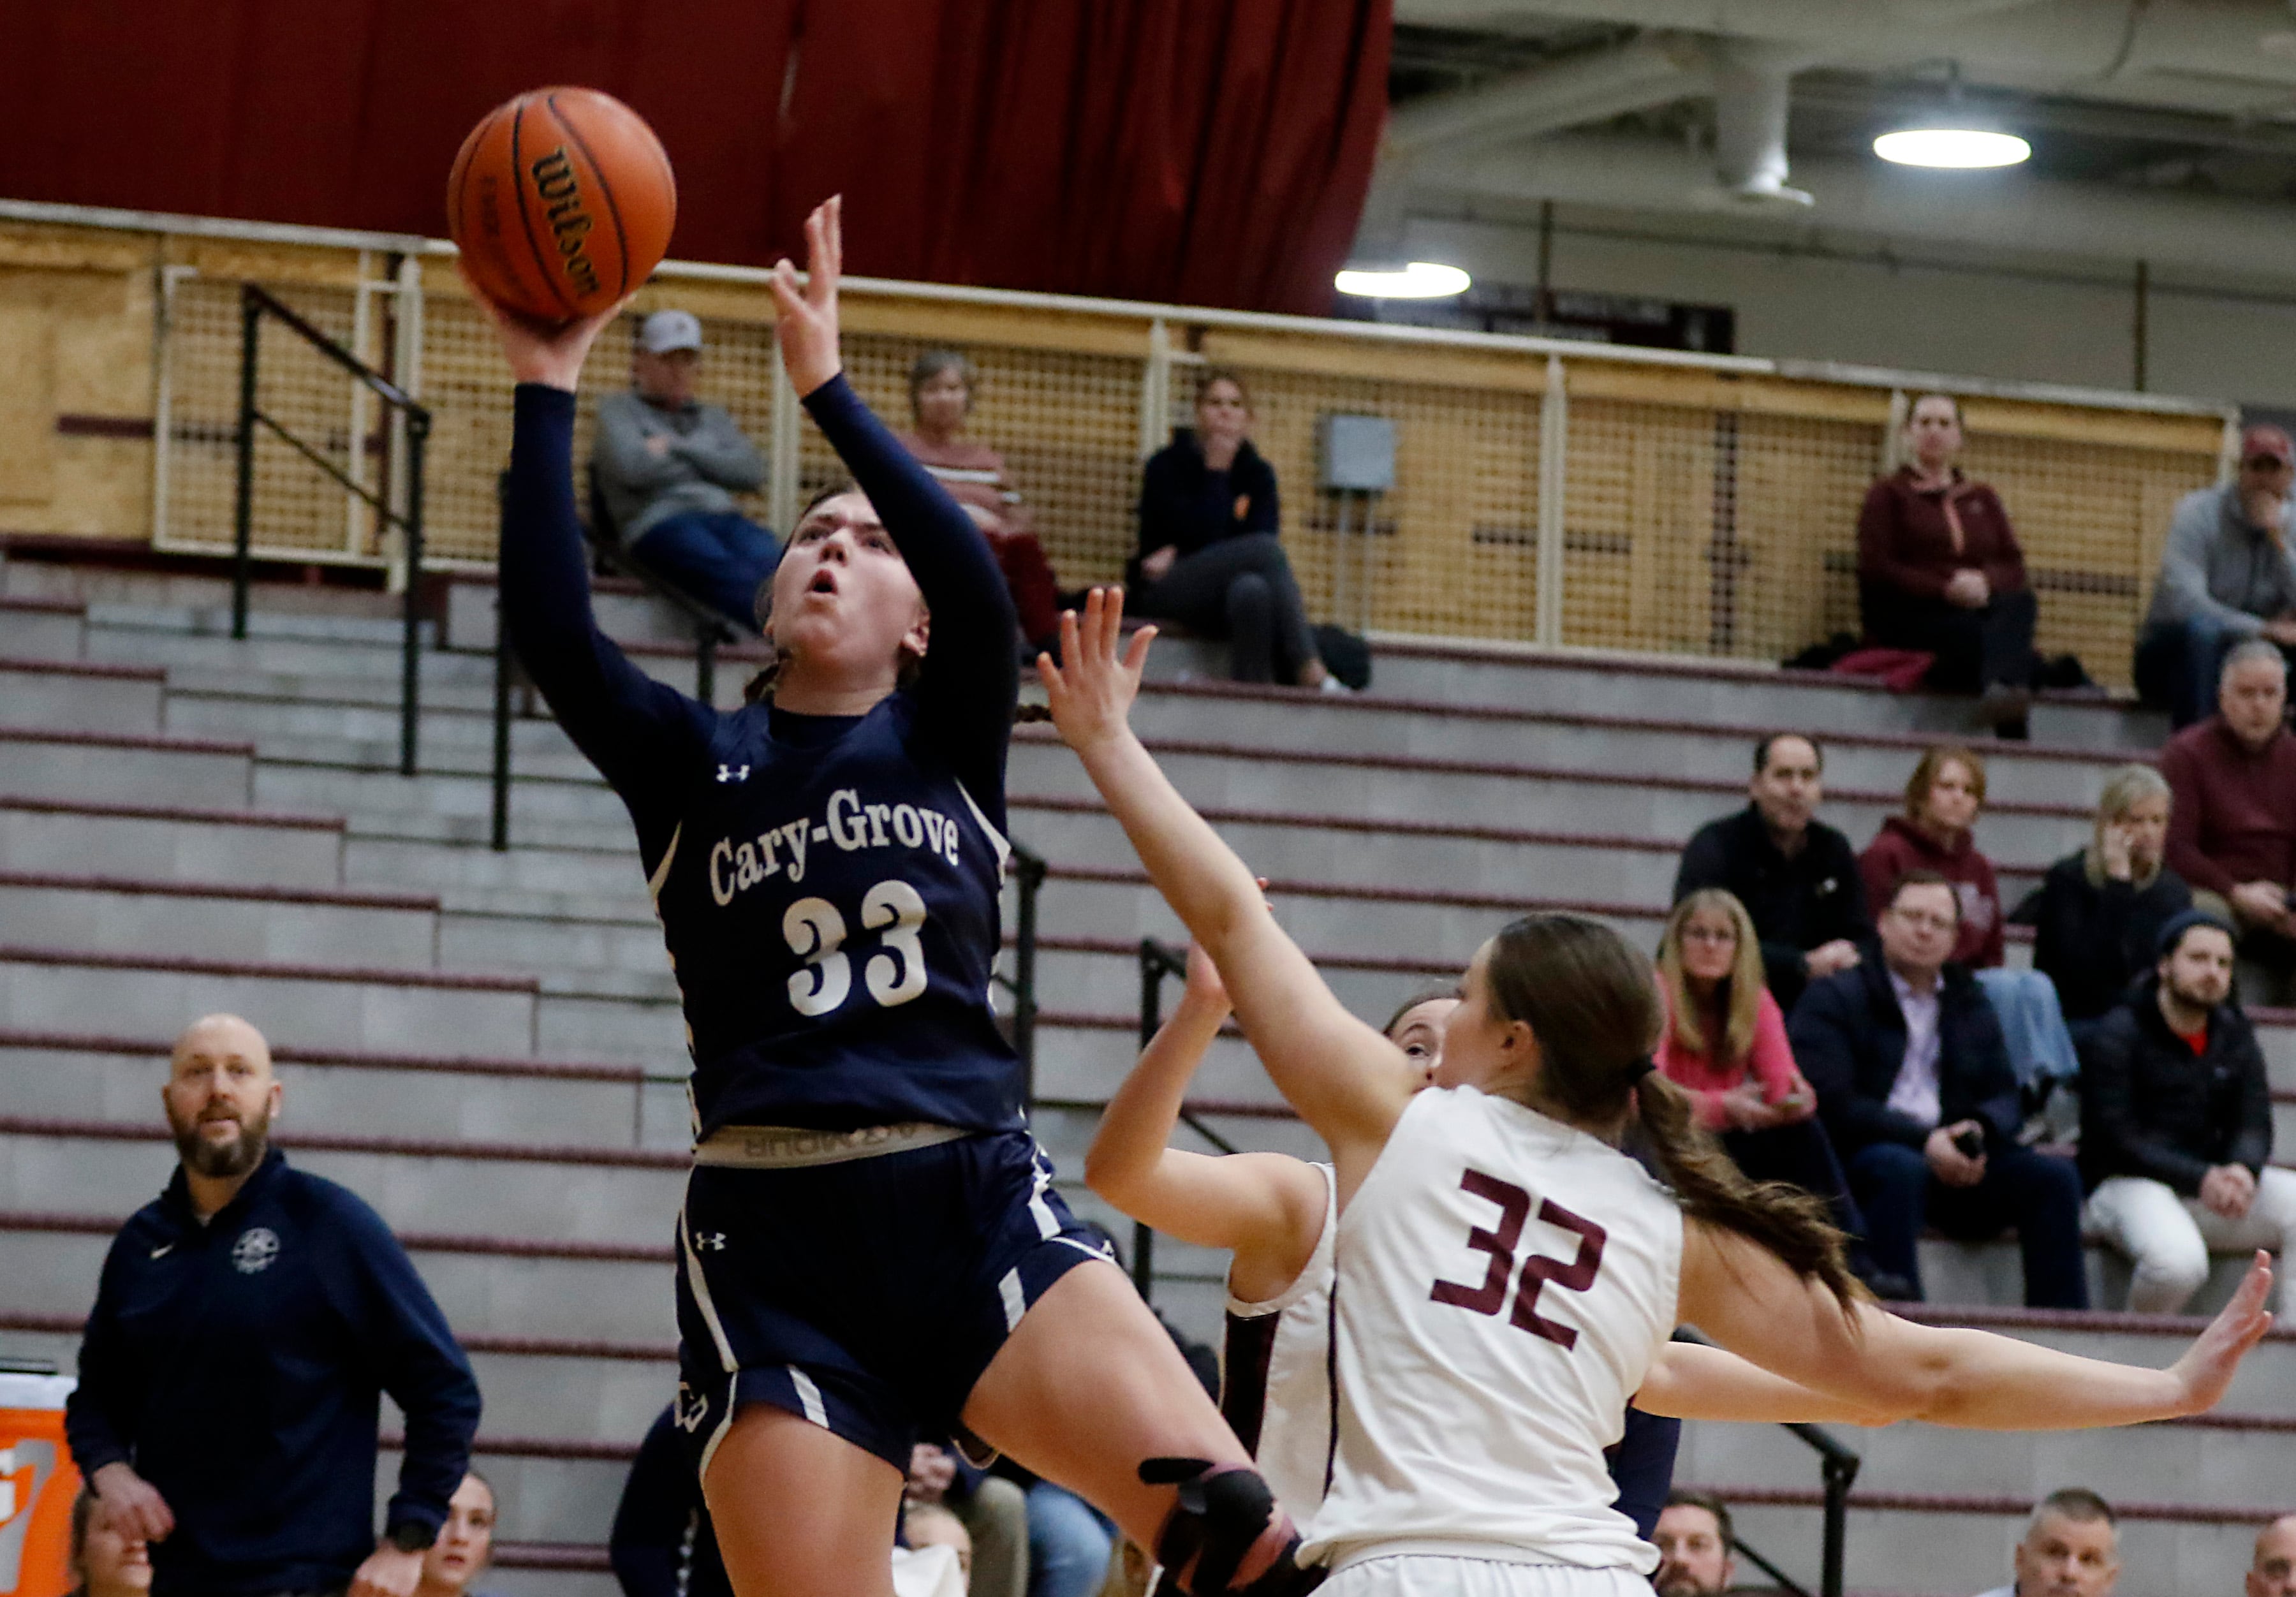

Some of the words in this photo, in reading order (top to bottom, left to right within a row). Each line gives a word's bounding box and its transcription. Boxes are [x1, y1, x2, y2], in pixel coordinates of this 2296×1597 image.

[531, 146, 601, 294] Wilson
[709, 788, 959, 907] Cary-Grove
[782, 879, 929, 1017] 33
[1429, 1166, 1607, 1353] 32
